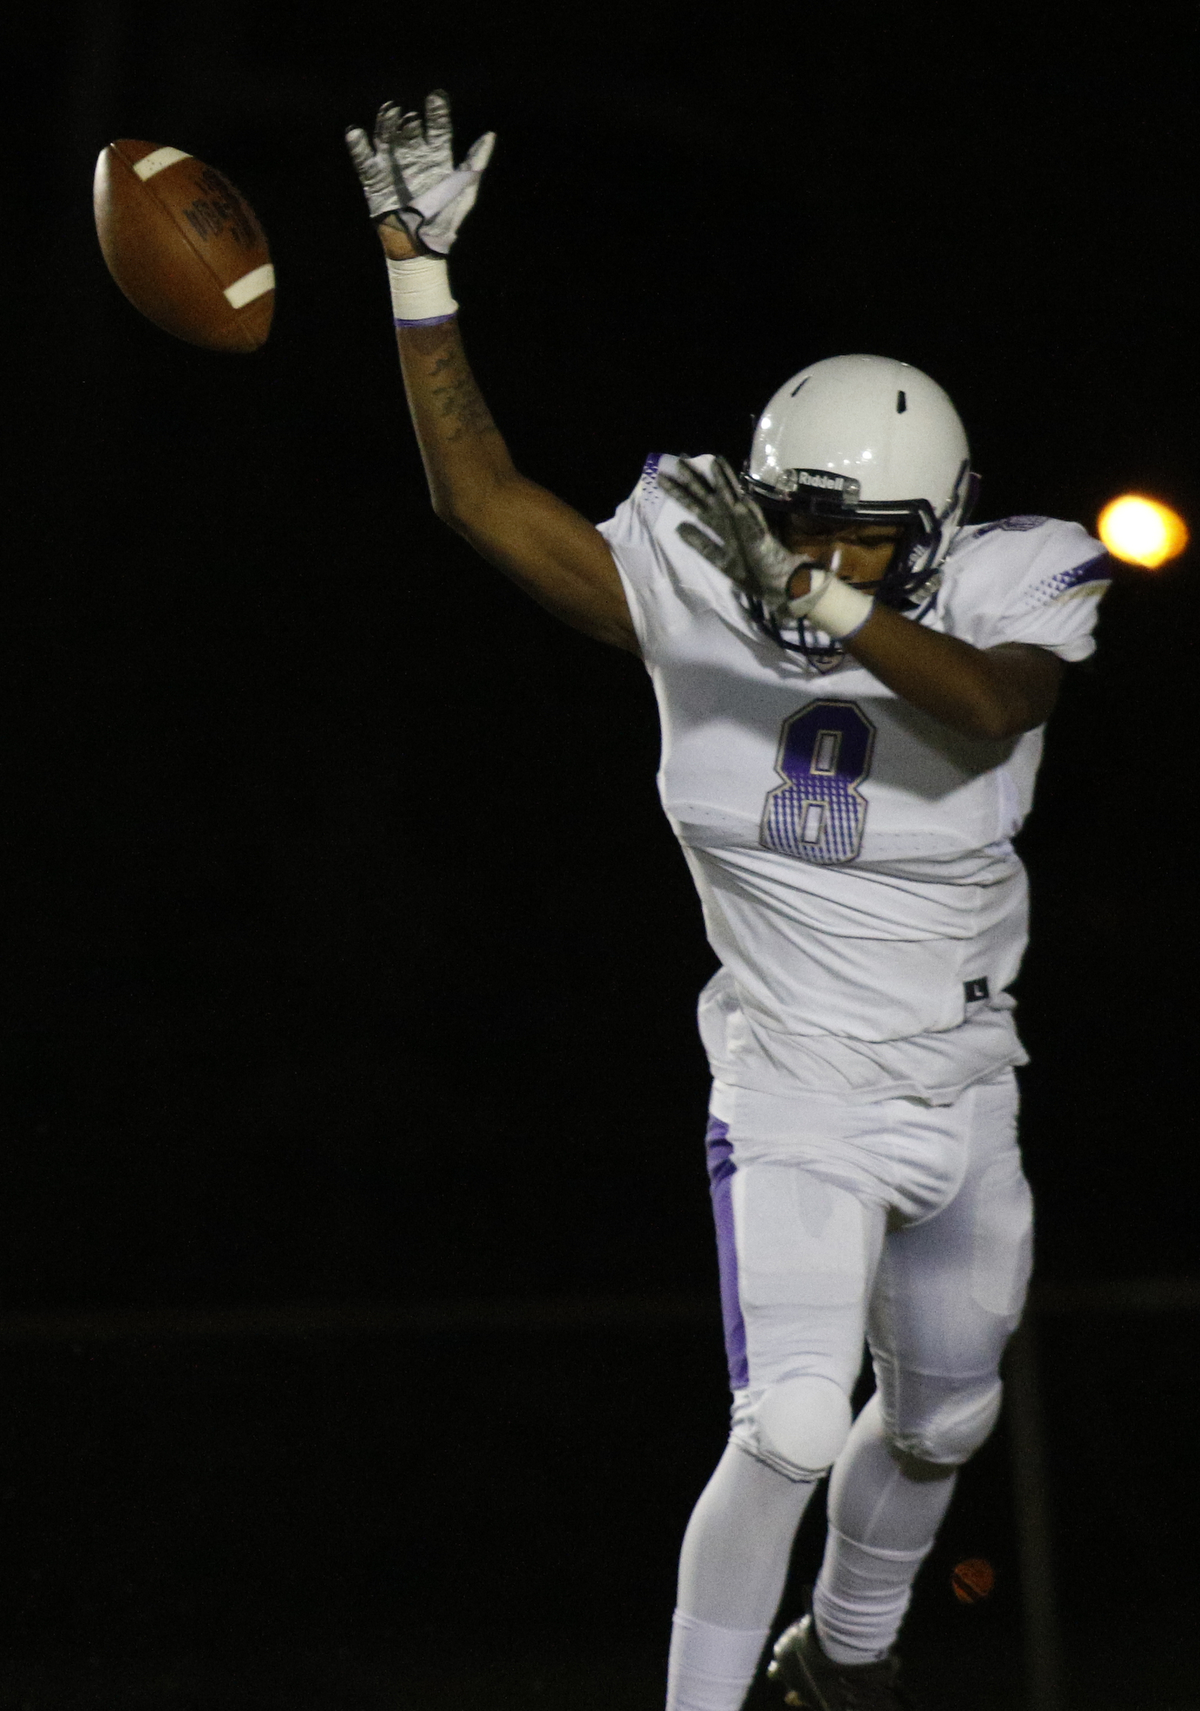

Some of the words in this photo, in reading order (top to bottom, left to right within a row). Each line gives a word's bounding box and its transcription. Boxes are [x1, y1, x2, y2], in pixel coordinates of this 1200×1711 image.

[799, 471, 844, 491] Riddell
[760, 698, 876, 866] 8
[973, 984, 984, 997] L
